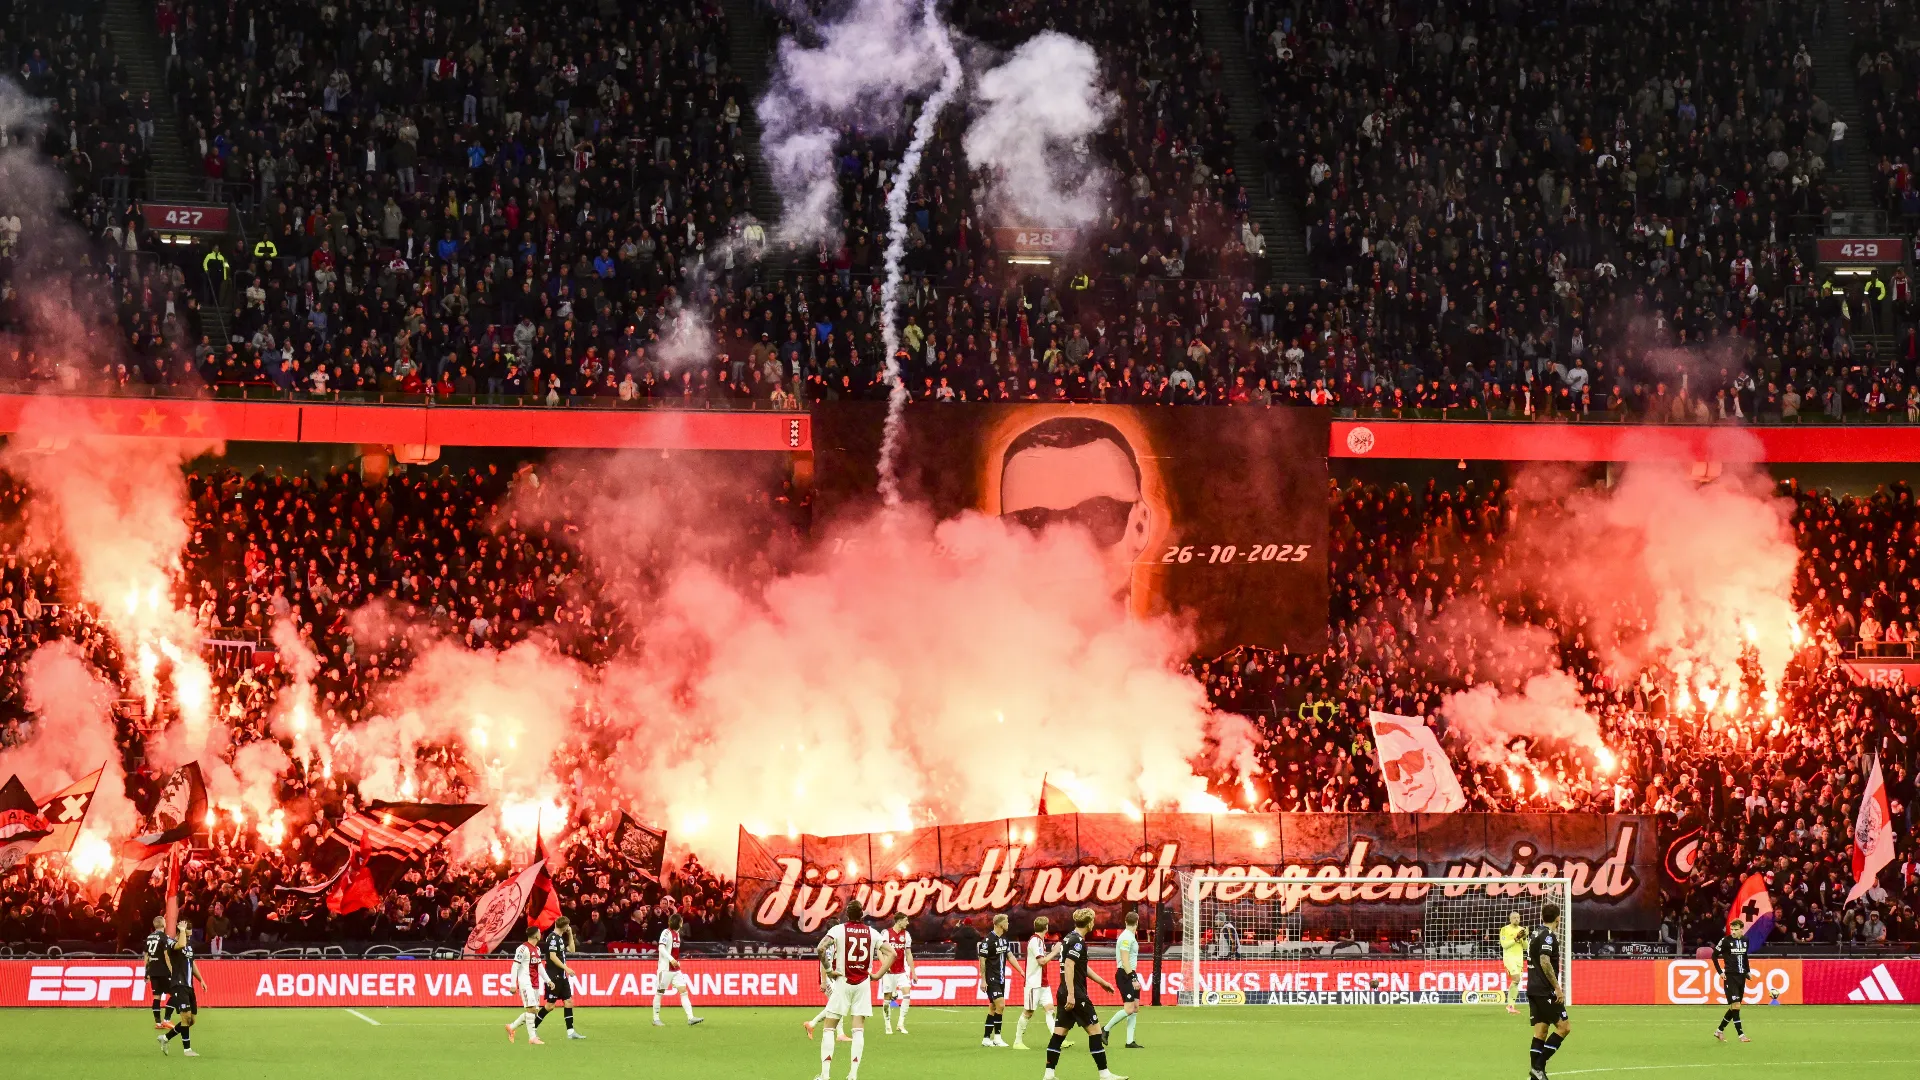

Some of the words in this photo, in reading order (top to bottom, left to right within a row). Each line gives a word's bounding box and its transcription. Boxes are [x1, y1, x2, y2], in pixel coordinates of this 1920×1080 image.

[165, 210, 203, 225] 427
[1016, 232, 1054, 246] 428
[1840, 243, 1879, 257] 429
[1160, 544, 1313, 564] 26-10-2025
[1869, 668, 1901, 683] 128
[856, 844, 1025, 918] wordt
[1029, 843, 1176, 903] nooit
[1185, 841, 1427, 914] vergeten
[1445, 826, 1634, 897] vriend
[847, 936, 869, 962] 25
[256, 973, 416, 997] ABONNEER
[424, 973, 473, 997] VIA
[1197, 972, 1261, 992] NIKS
[1269, 972, 1328, 992] MET
[1336, 972, 1409, 992] ESPN
[1267, 992, 1338, 1004] ALLSAFE
[1341, 992, 1376, 1004] MINI
[1379, 991, 1440, 1005] OPSLAG
